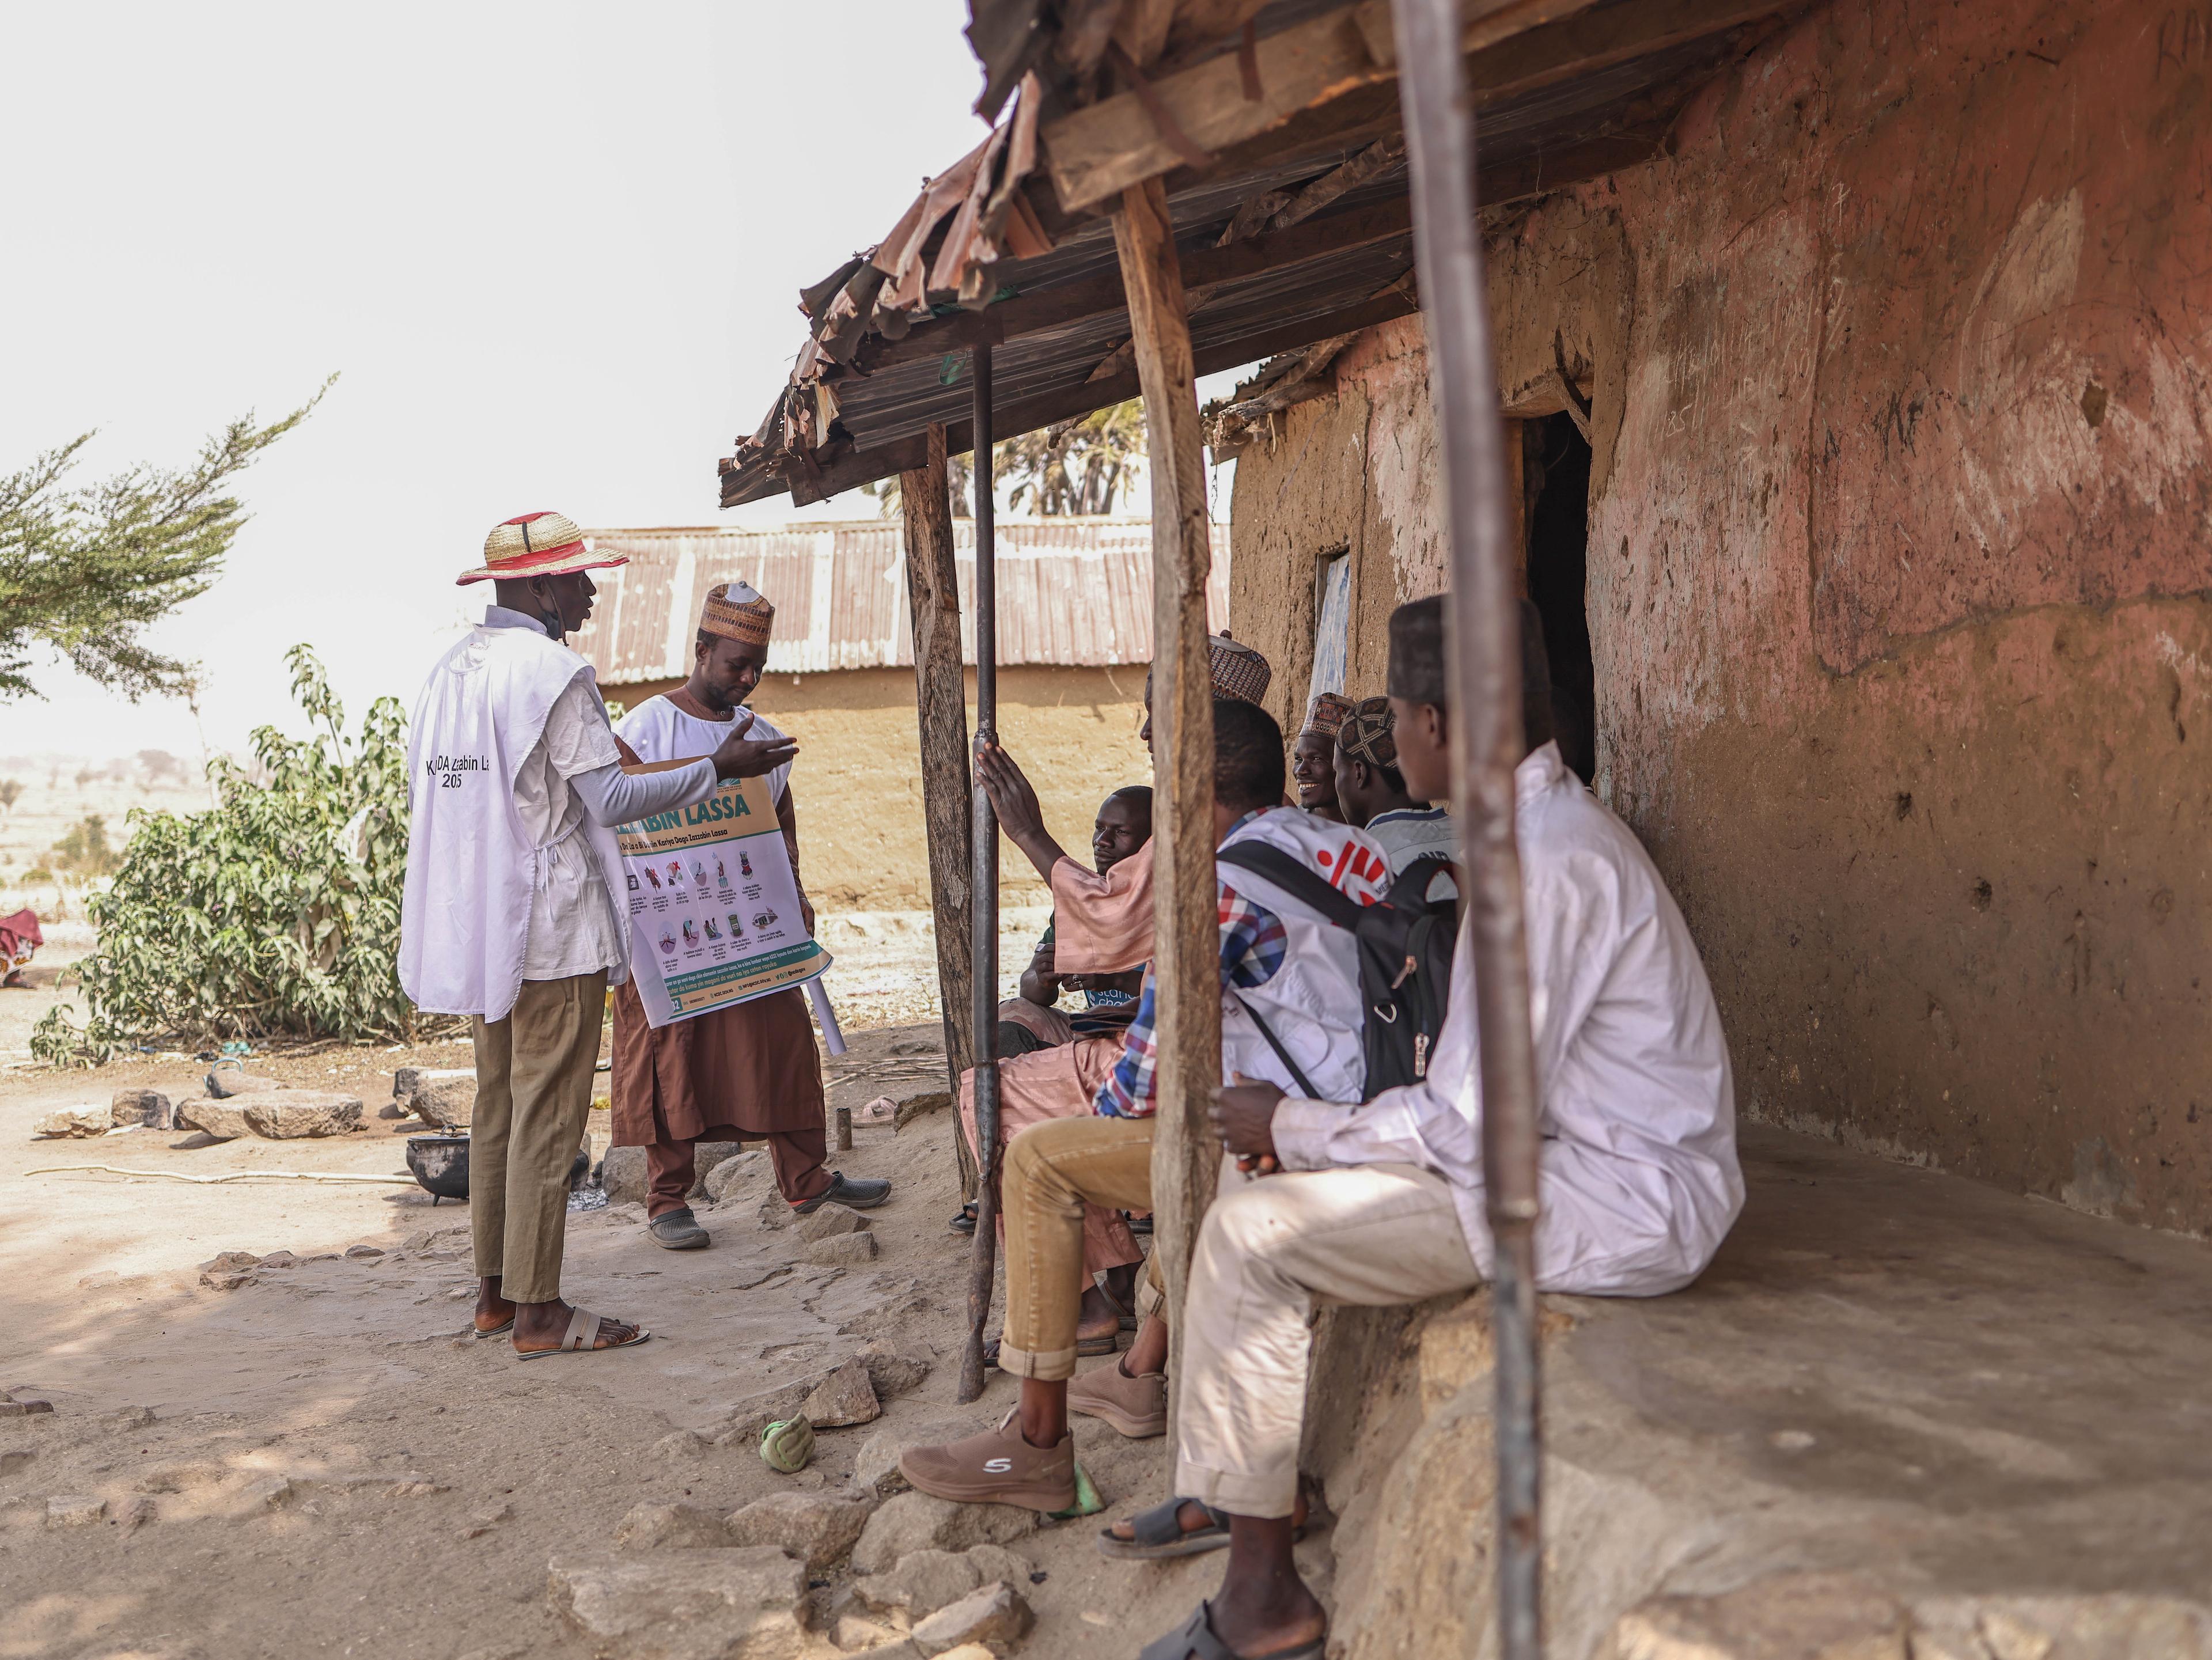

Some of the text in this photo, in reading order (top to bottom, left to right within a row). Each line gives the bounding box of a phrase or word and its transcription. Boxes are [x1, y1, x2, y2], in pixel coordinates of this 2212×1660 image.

[685, 794, 751, 826] LASSA
[657, 839, 675, 847] Kariya
[675, 836, 688, 844] Daga
[688, 831, 711, 841] Zazzabin
